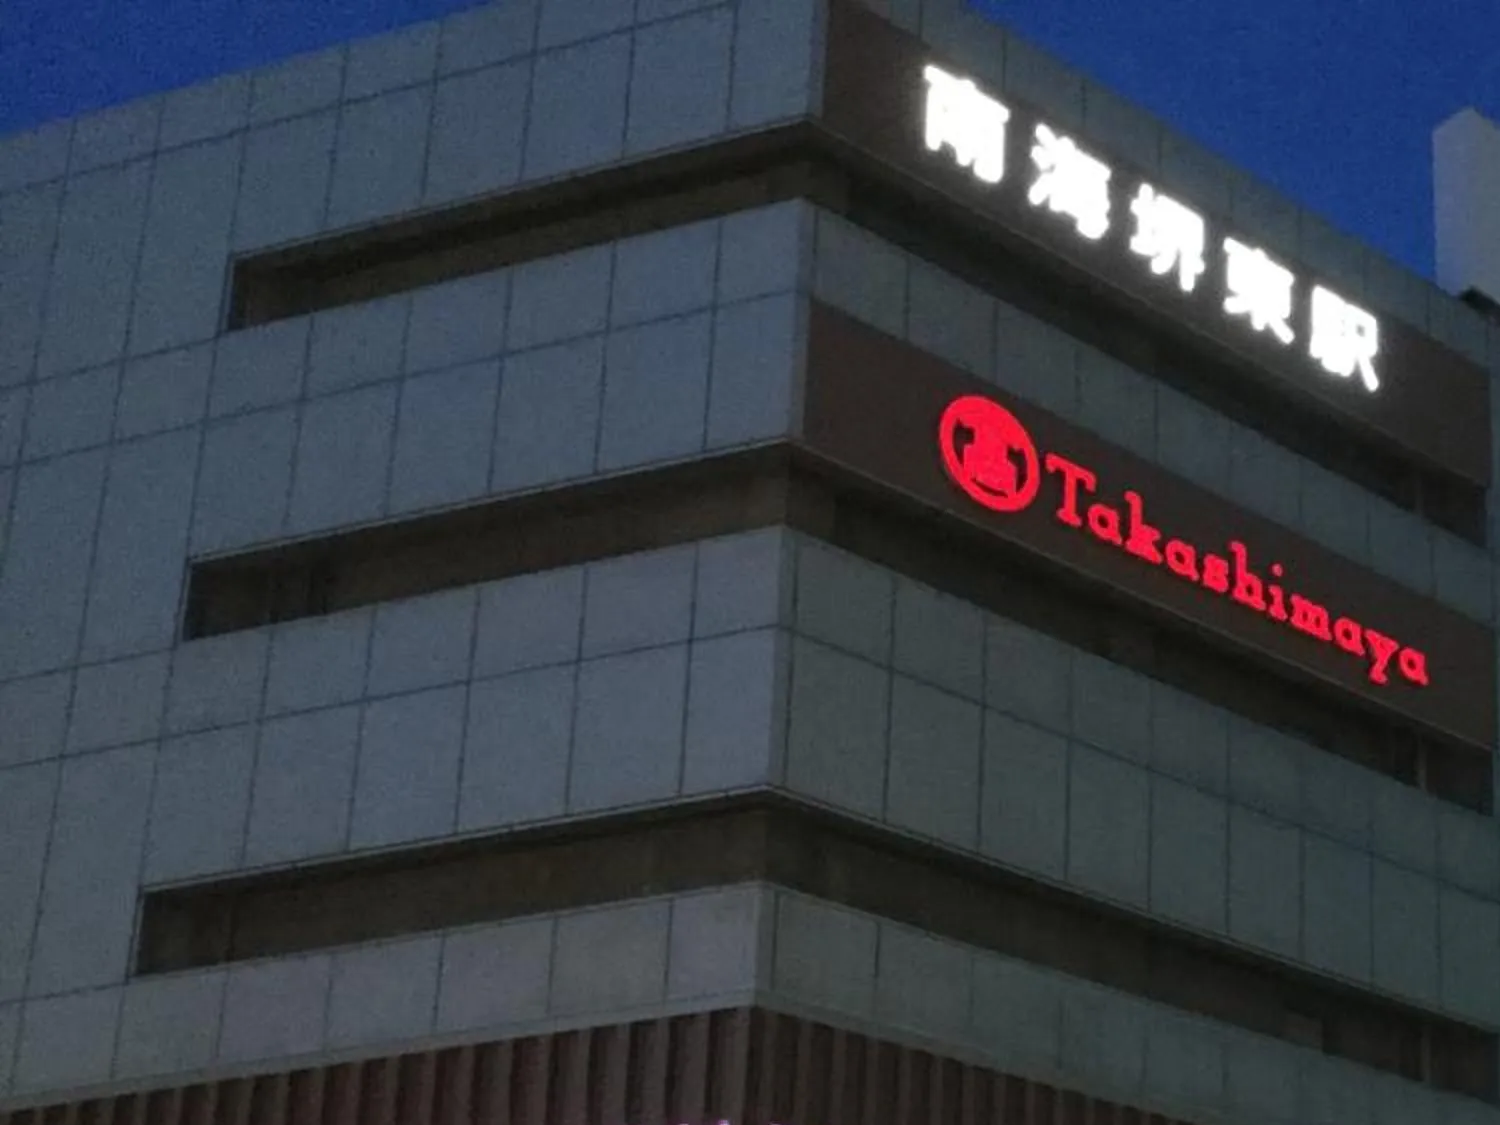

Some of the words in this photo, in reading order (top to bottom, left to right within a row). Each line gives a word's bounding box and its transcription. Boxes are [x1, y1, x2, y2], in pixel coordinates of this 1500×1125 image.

[924, 65, 1380, 391] 南海堺東駅
[1045, 453, 1428, 685] Takashimaya
